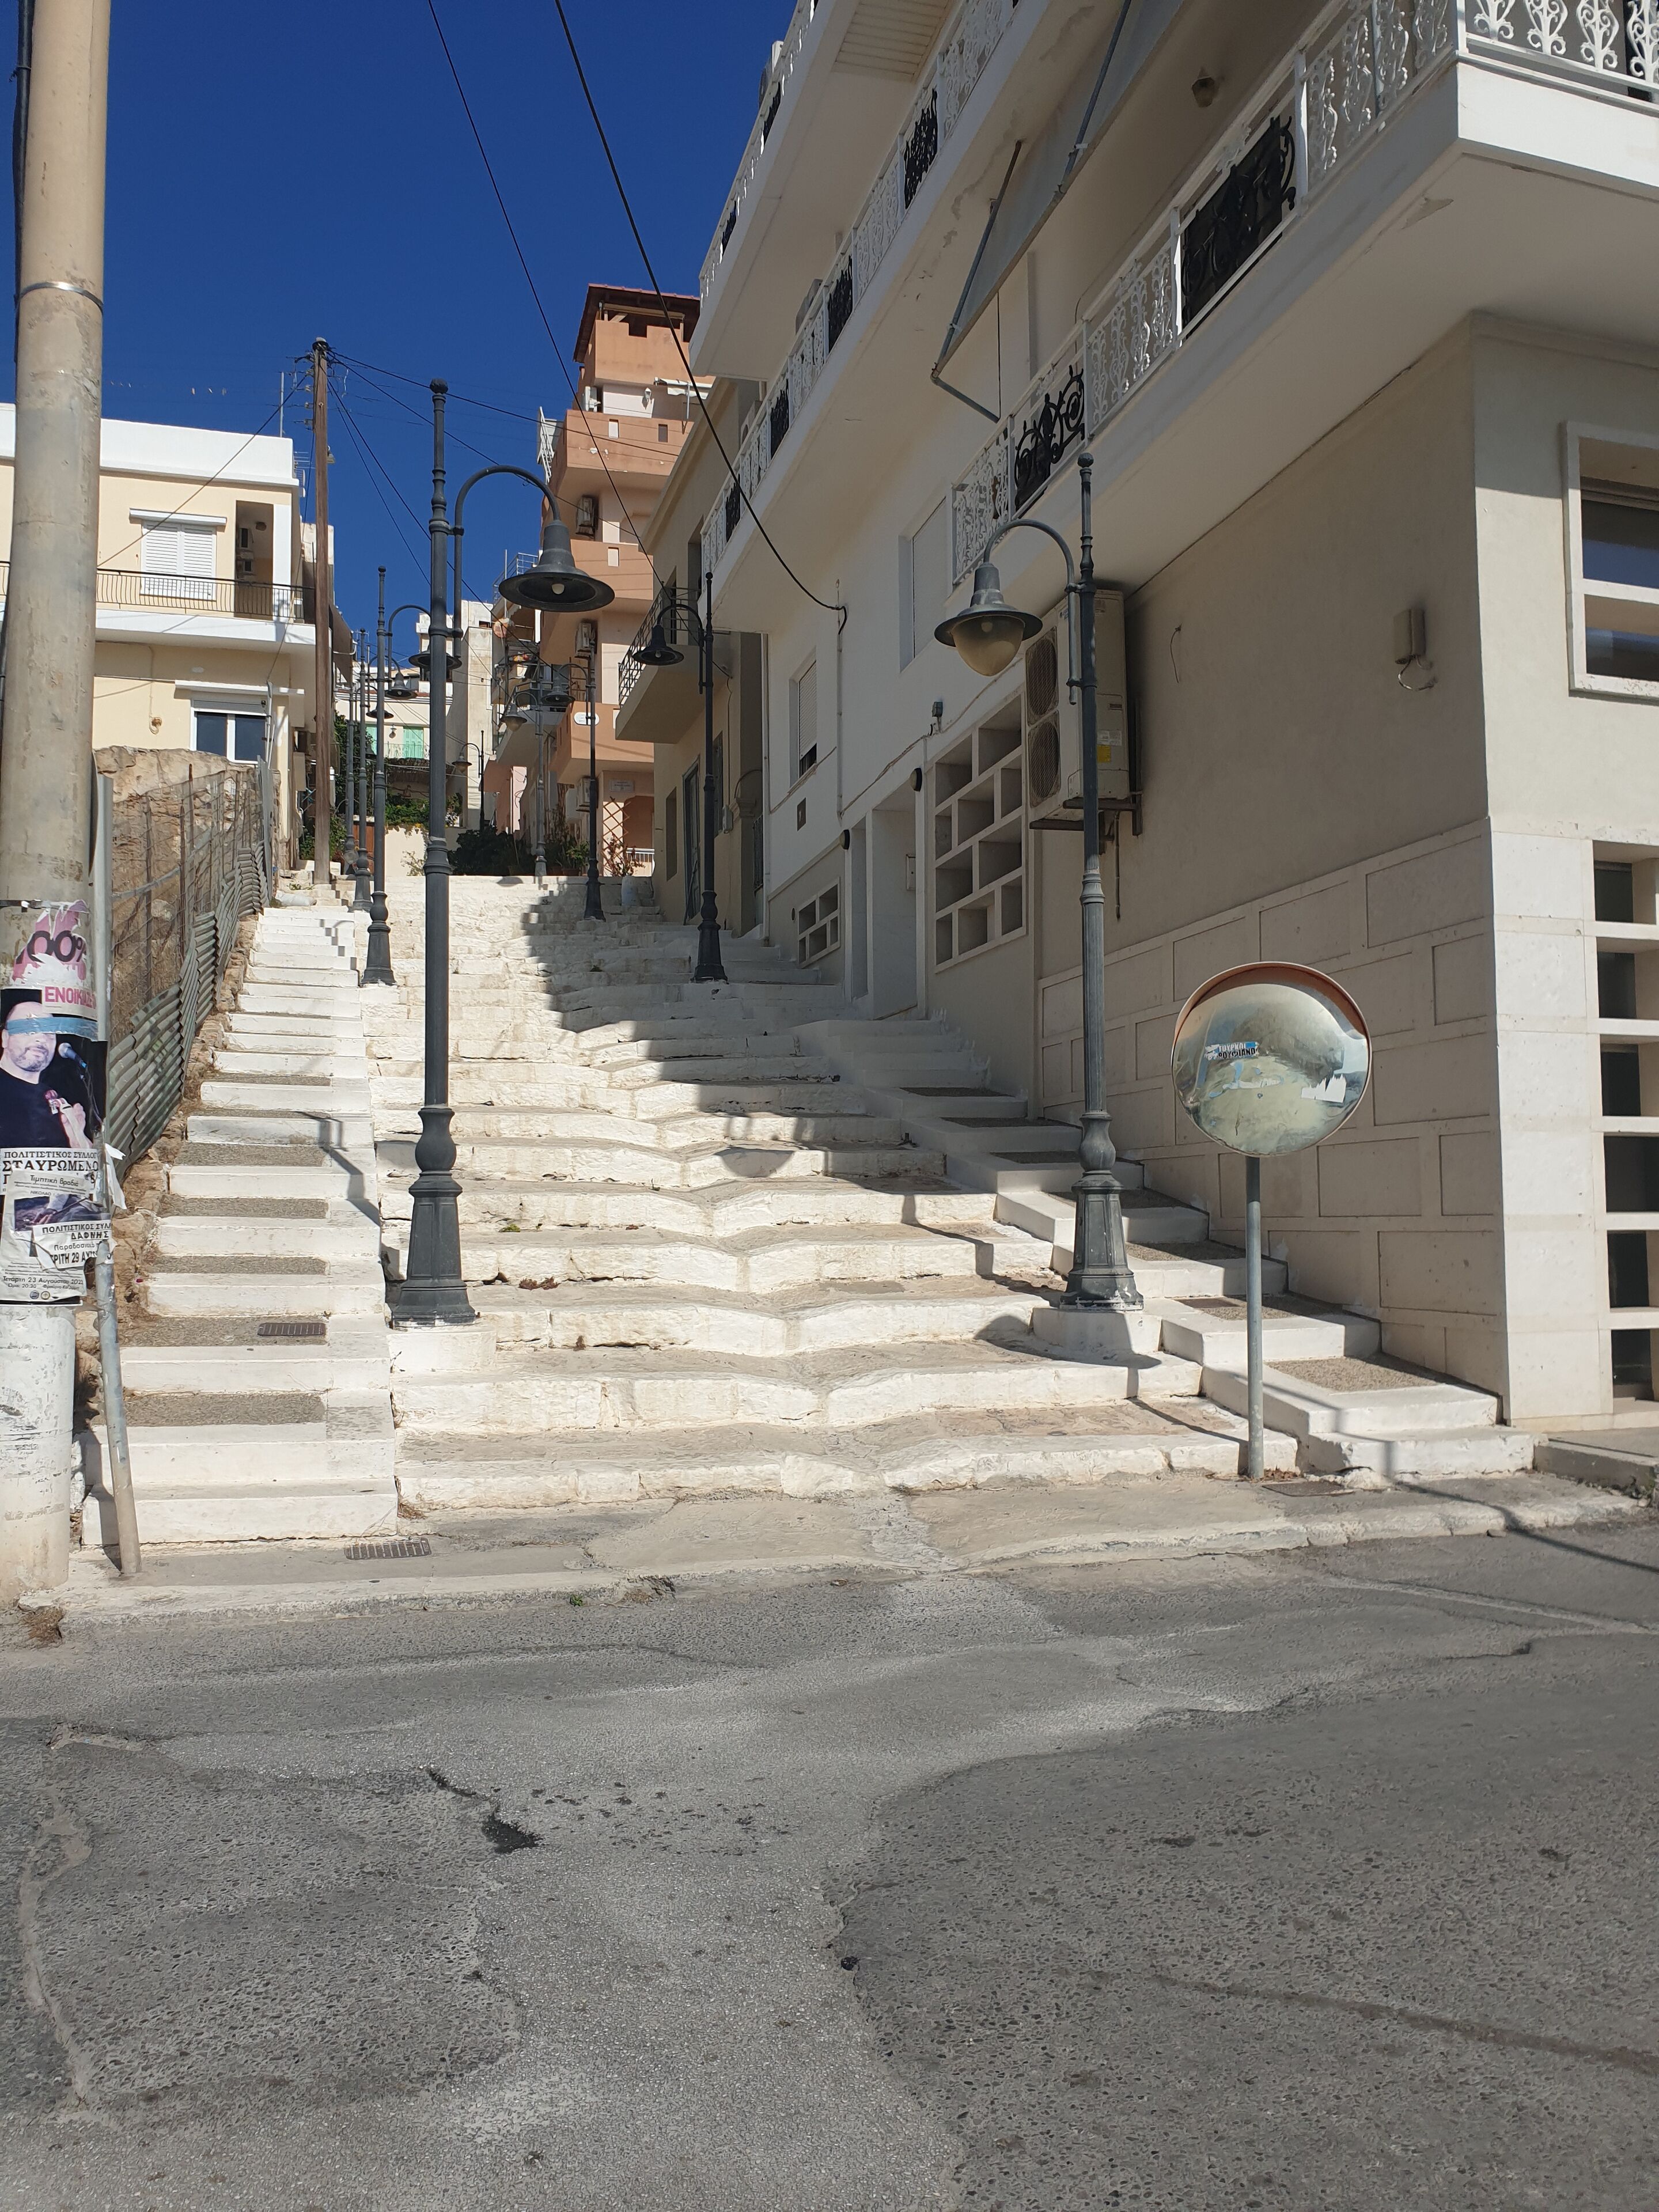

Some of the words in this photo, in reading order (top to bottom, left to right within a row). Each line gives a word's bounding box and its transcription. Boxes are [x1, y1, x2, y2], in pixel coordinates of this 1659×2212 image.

[1217, 1047, 1258, 1059] ΡΟΥΦΙΑΝΟ
[4, 1151, 72, 1159] ΠΟΛΙΤΙΣΤΙΚΟΣ
[30, 1175, 58, 1185] Τιμητική
[42, 1224, 94, 1233] ΠΟΛΙΤΙΣΤΙΚΟΣ
[71, 1231, 109, 1240] ΔΑΦΝΗΣ
[71, 1252, 79, 1263] 29
